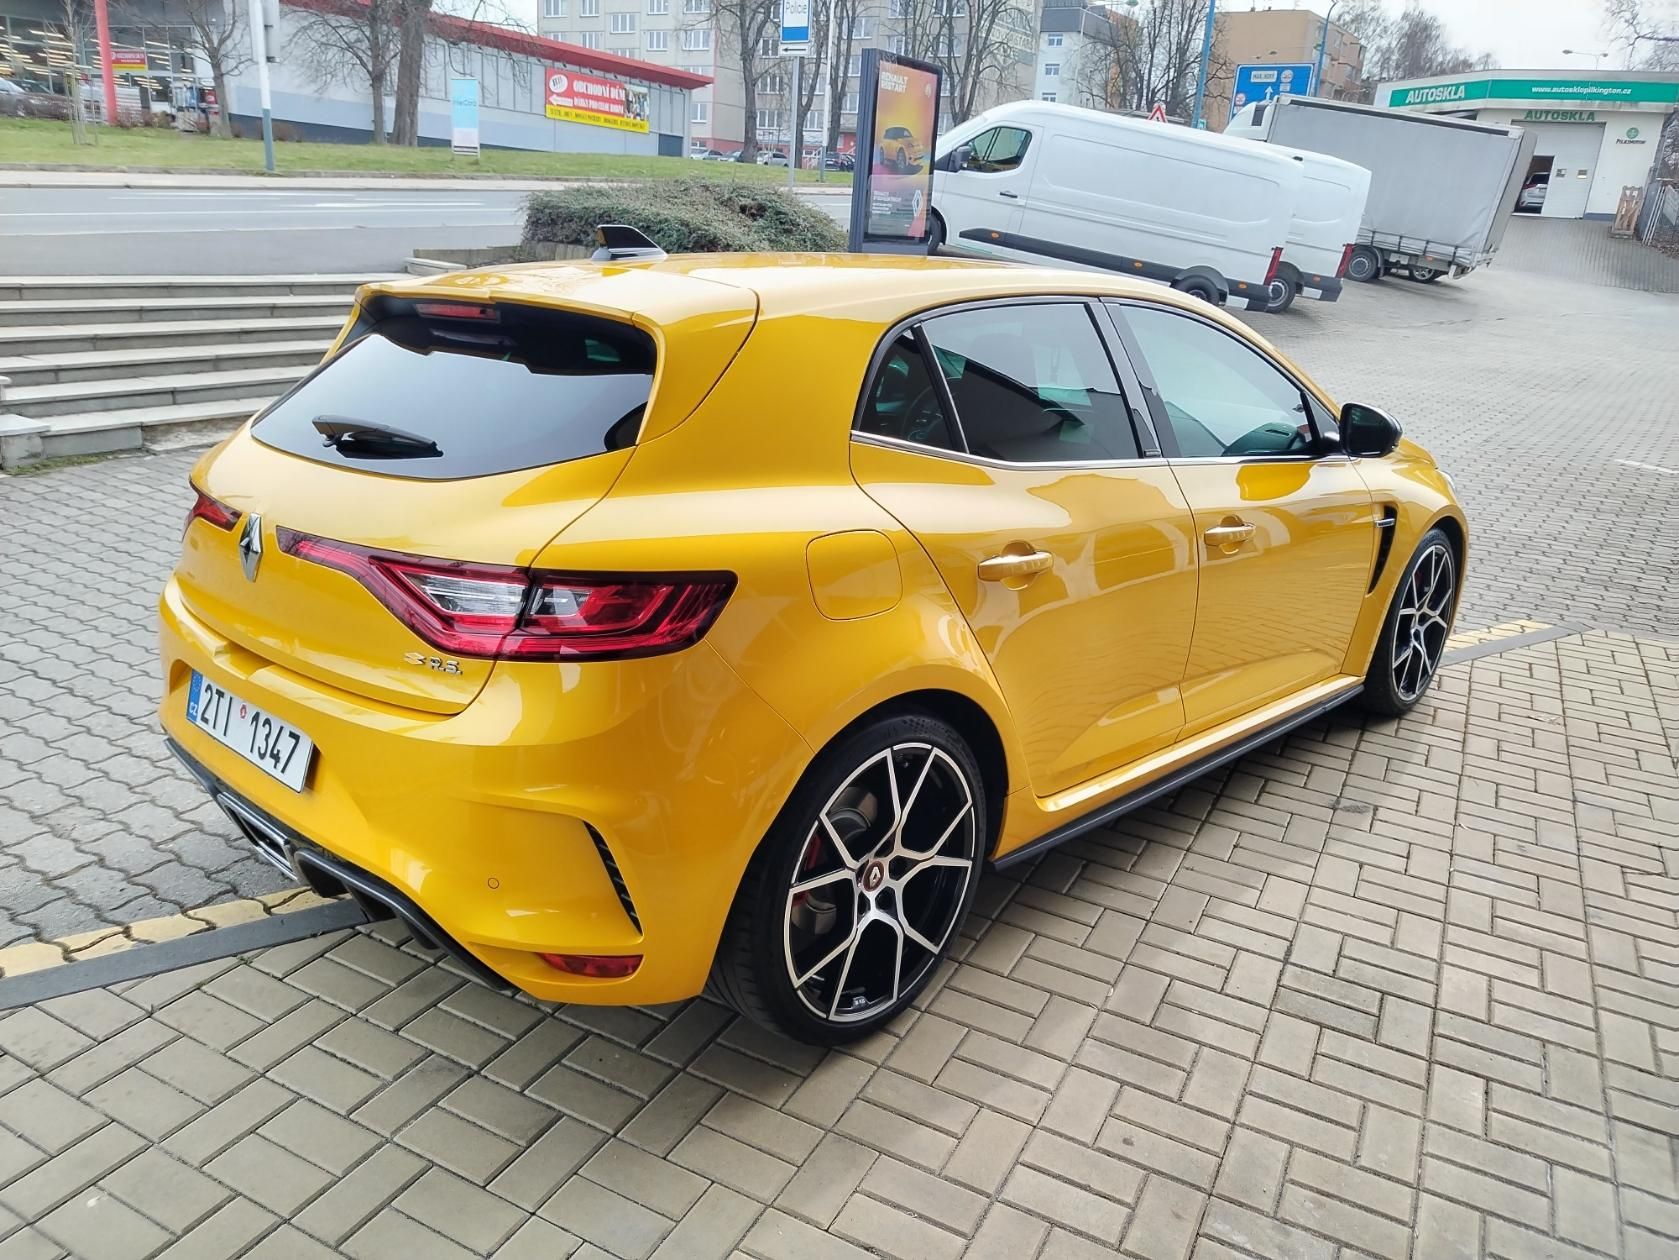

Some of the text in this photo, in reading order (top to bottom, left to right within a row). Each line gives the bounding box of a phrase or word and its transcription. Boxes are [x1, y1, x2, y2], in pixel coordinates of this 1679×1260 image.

[1405, 85, 1465, 104] AUTOSKLA
[1524, 109, 1595, 122] AUTOSKLA
[200, 683, 301, 774] 2TI 1347
